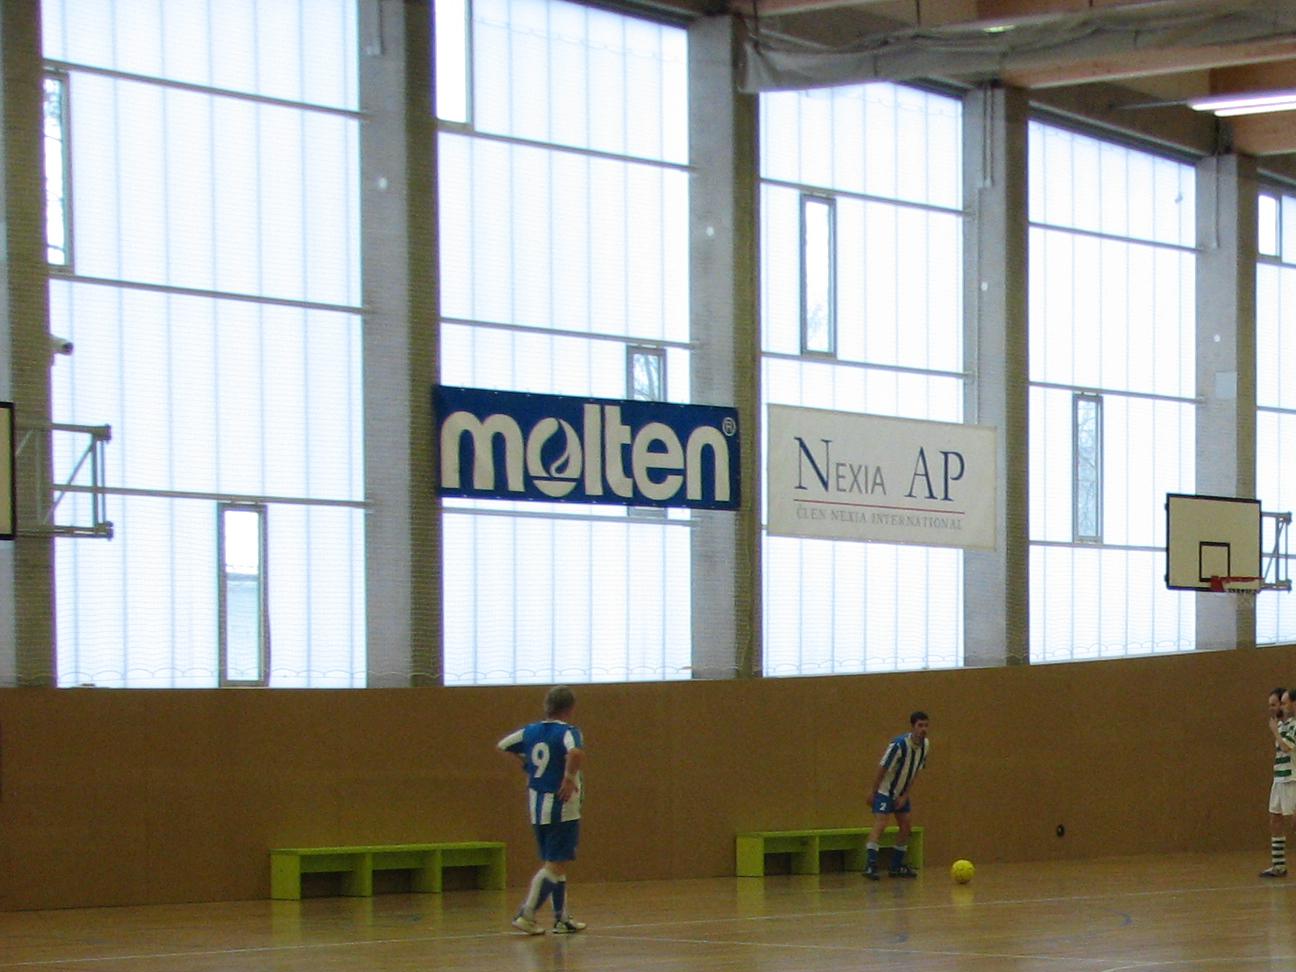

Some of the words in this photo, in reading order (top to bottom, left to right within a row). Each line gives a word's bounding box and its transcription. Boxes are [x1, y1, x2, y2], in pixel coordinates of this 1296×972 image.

[904, 446, 966, 502] AP
[830, 510, 866, 524] NEXIA
[872, 513, 962, 530] INTERNATIONAL
[531, 741, 550, 778] 9
